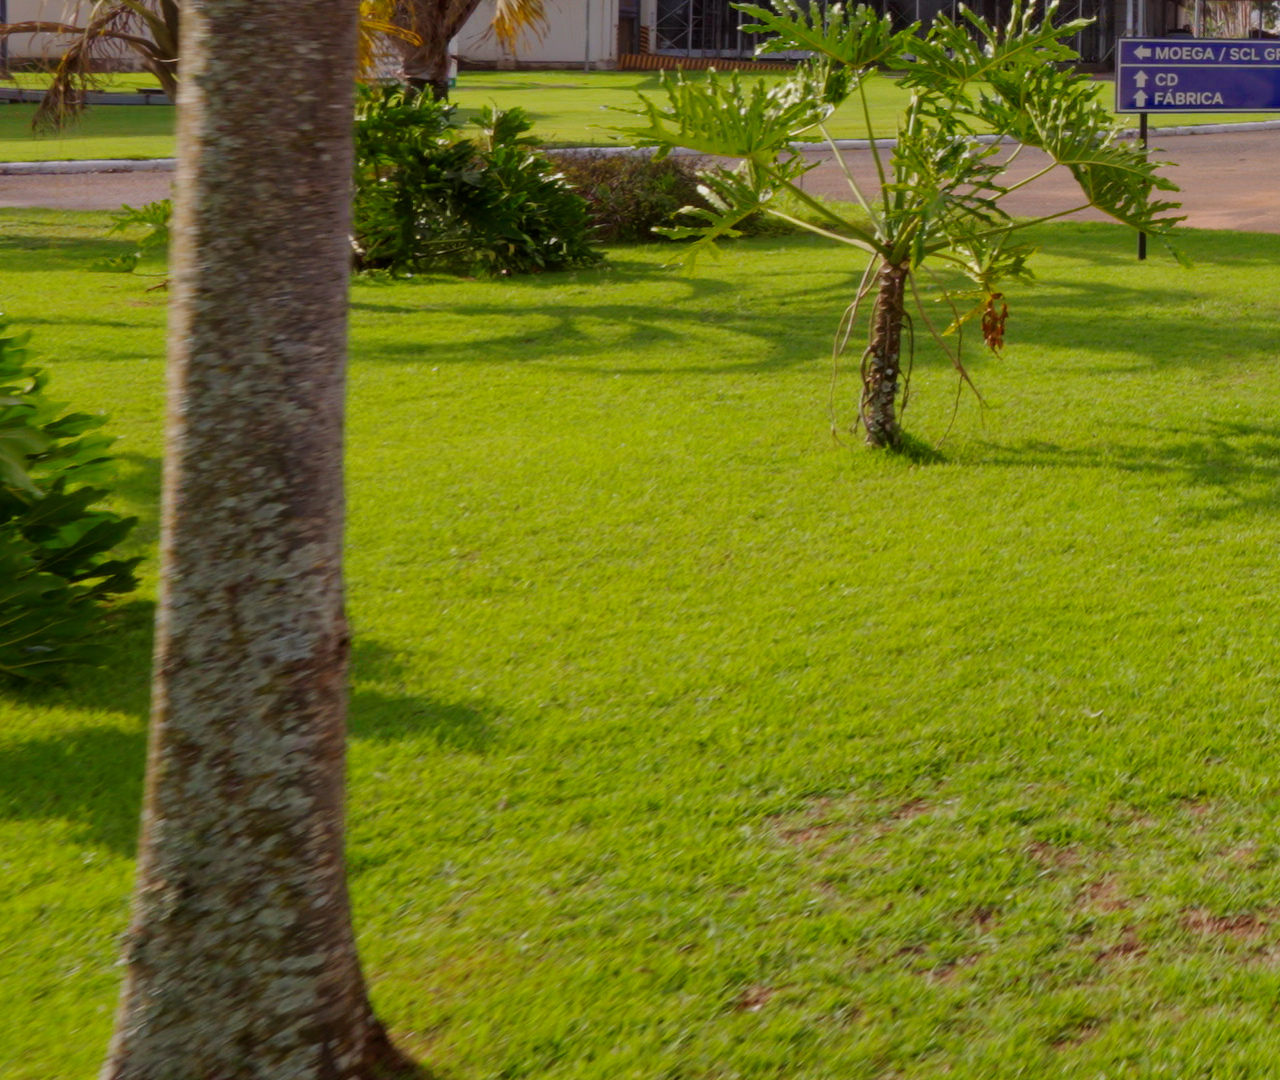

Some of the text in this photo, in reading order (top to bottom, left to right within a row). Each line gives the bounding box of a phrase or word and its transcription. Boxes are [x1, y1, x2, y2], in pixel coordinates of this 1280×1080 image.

[1154, 47, 1215, 61] MOEGA
[1218, 47, 1227, 62] /
[1230, 48, 1260, 61] SCL
[1155, 73, 1178, 87] CD
[1154, 89, 1224, 105] FÁBRICA
